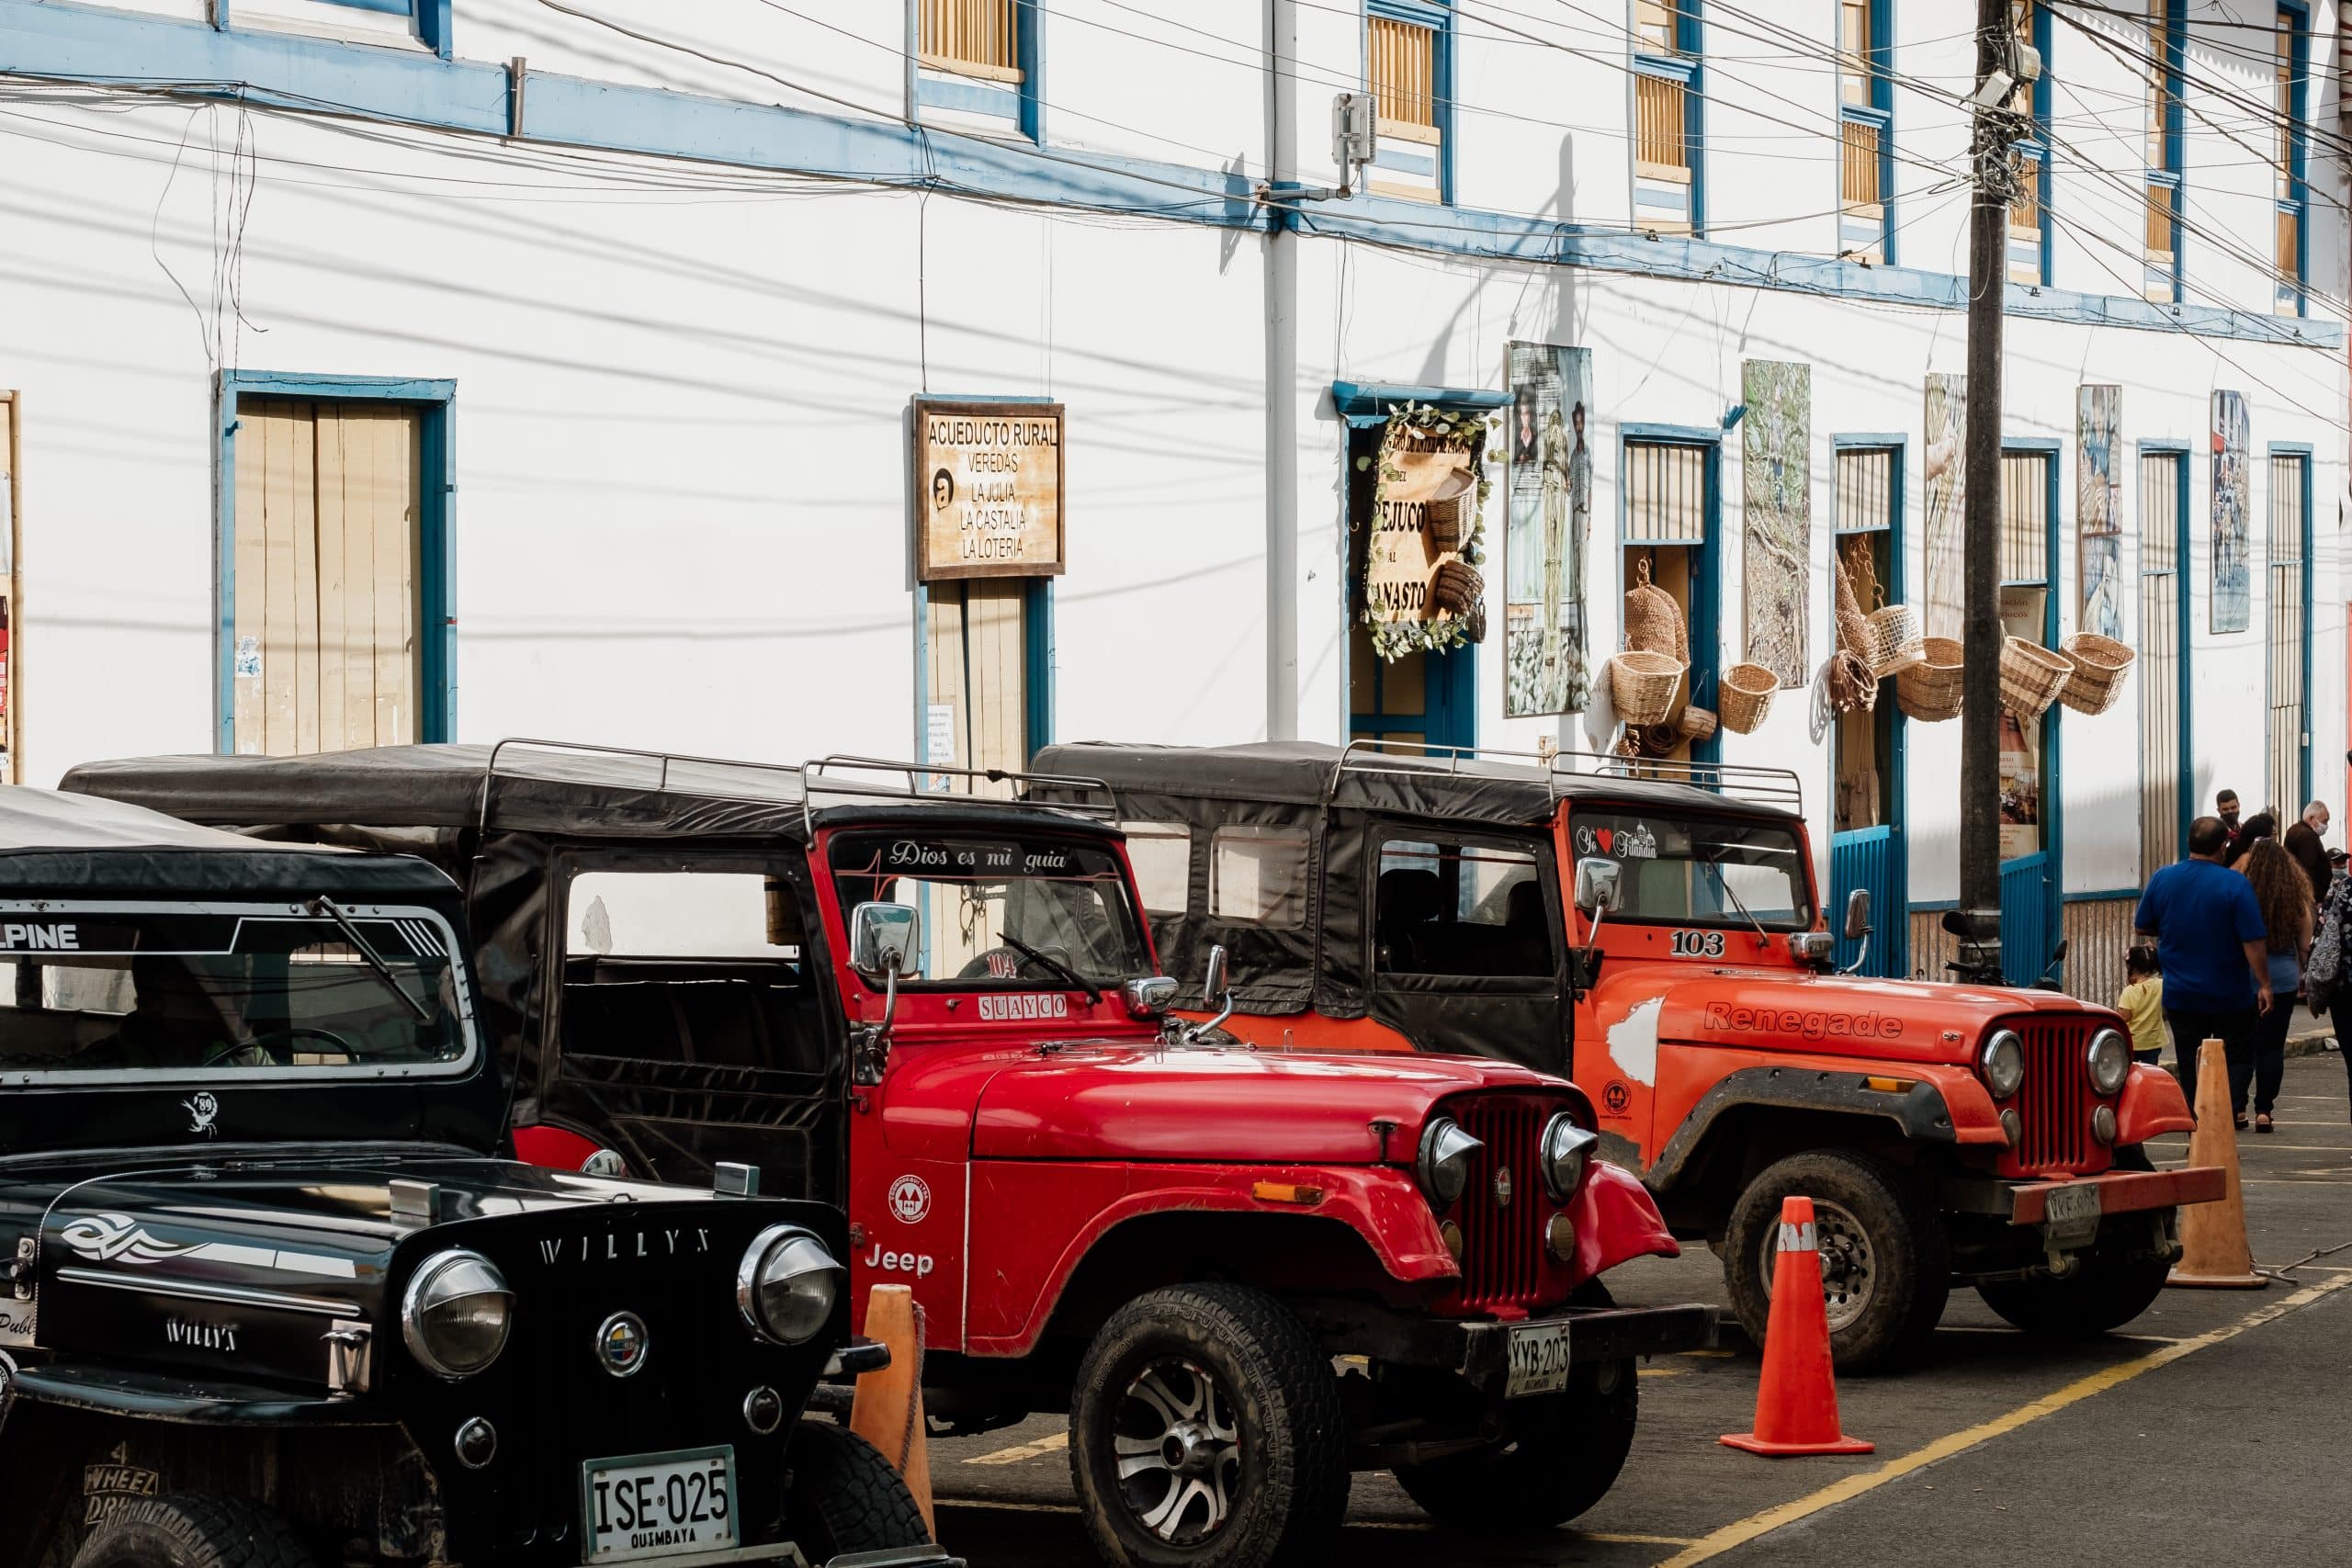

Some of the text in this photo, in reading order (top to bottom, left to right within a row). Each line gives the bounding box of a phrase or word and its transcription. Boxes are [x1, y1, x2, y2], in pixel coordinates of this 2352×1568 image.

[929, 422, 1057, 446] ACUEDUCTO RURAL
[967, 453, 1018, 473] VEREDAS
[971, 482, 1015, 502] LA JULIA
[960, 510, 1026, 531] LA CASTALIA
[963, 537, 1023, 558] LA LOTERIA
[1388, 552, 1397, 563] AL
[1375, 581, 1427, 610] NASTO
[1576, 826, 1597, 854] Yo
[888, 840, 1067, 874] Dios es mi guia
[0, 924, 80, 949] PINE
[1670, 930, 1725, 958] 103
[987, 953, 1017, 978] 104
[980, 997, 1066, 1017] SUAYCO
[1704, 1001, 1904, 1042] Renegade
[198, 1098, 212, 1111] 89
[865, 1243, 933, 1279] Jeep
[1511, 1336, 1568, 1376] YYB 203
[110, 1440, 127, 1465] 4
[85, 1467, 157, 1495] WHEEL
[594, 1469, 729, 1534] ISE 025
